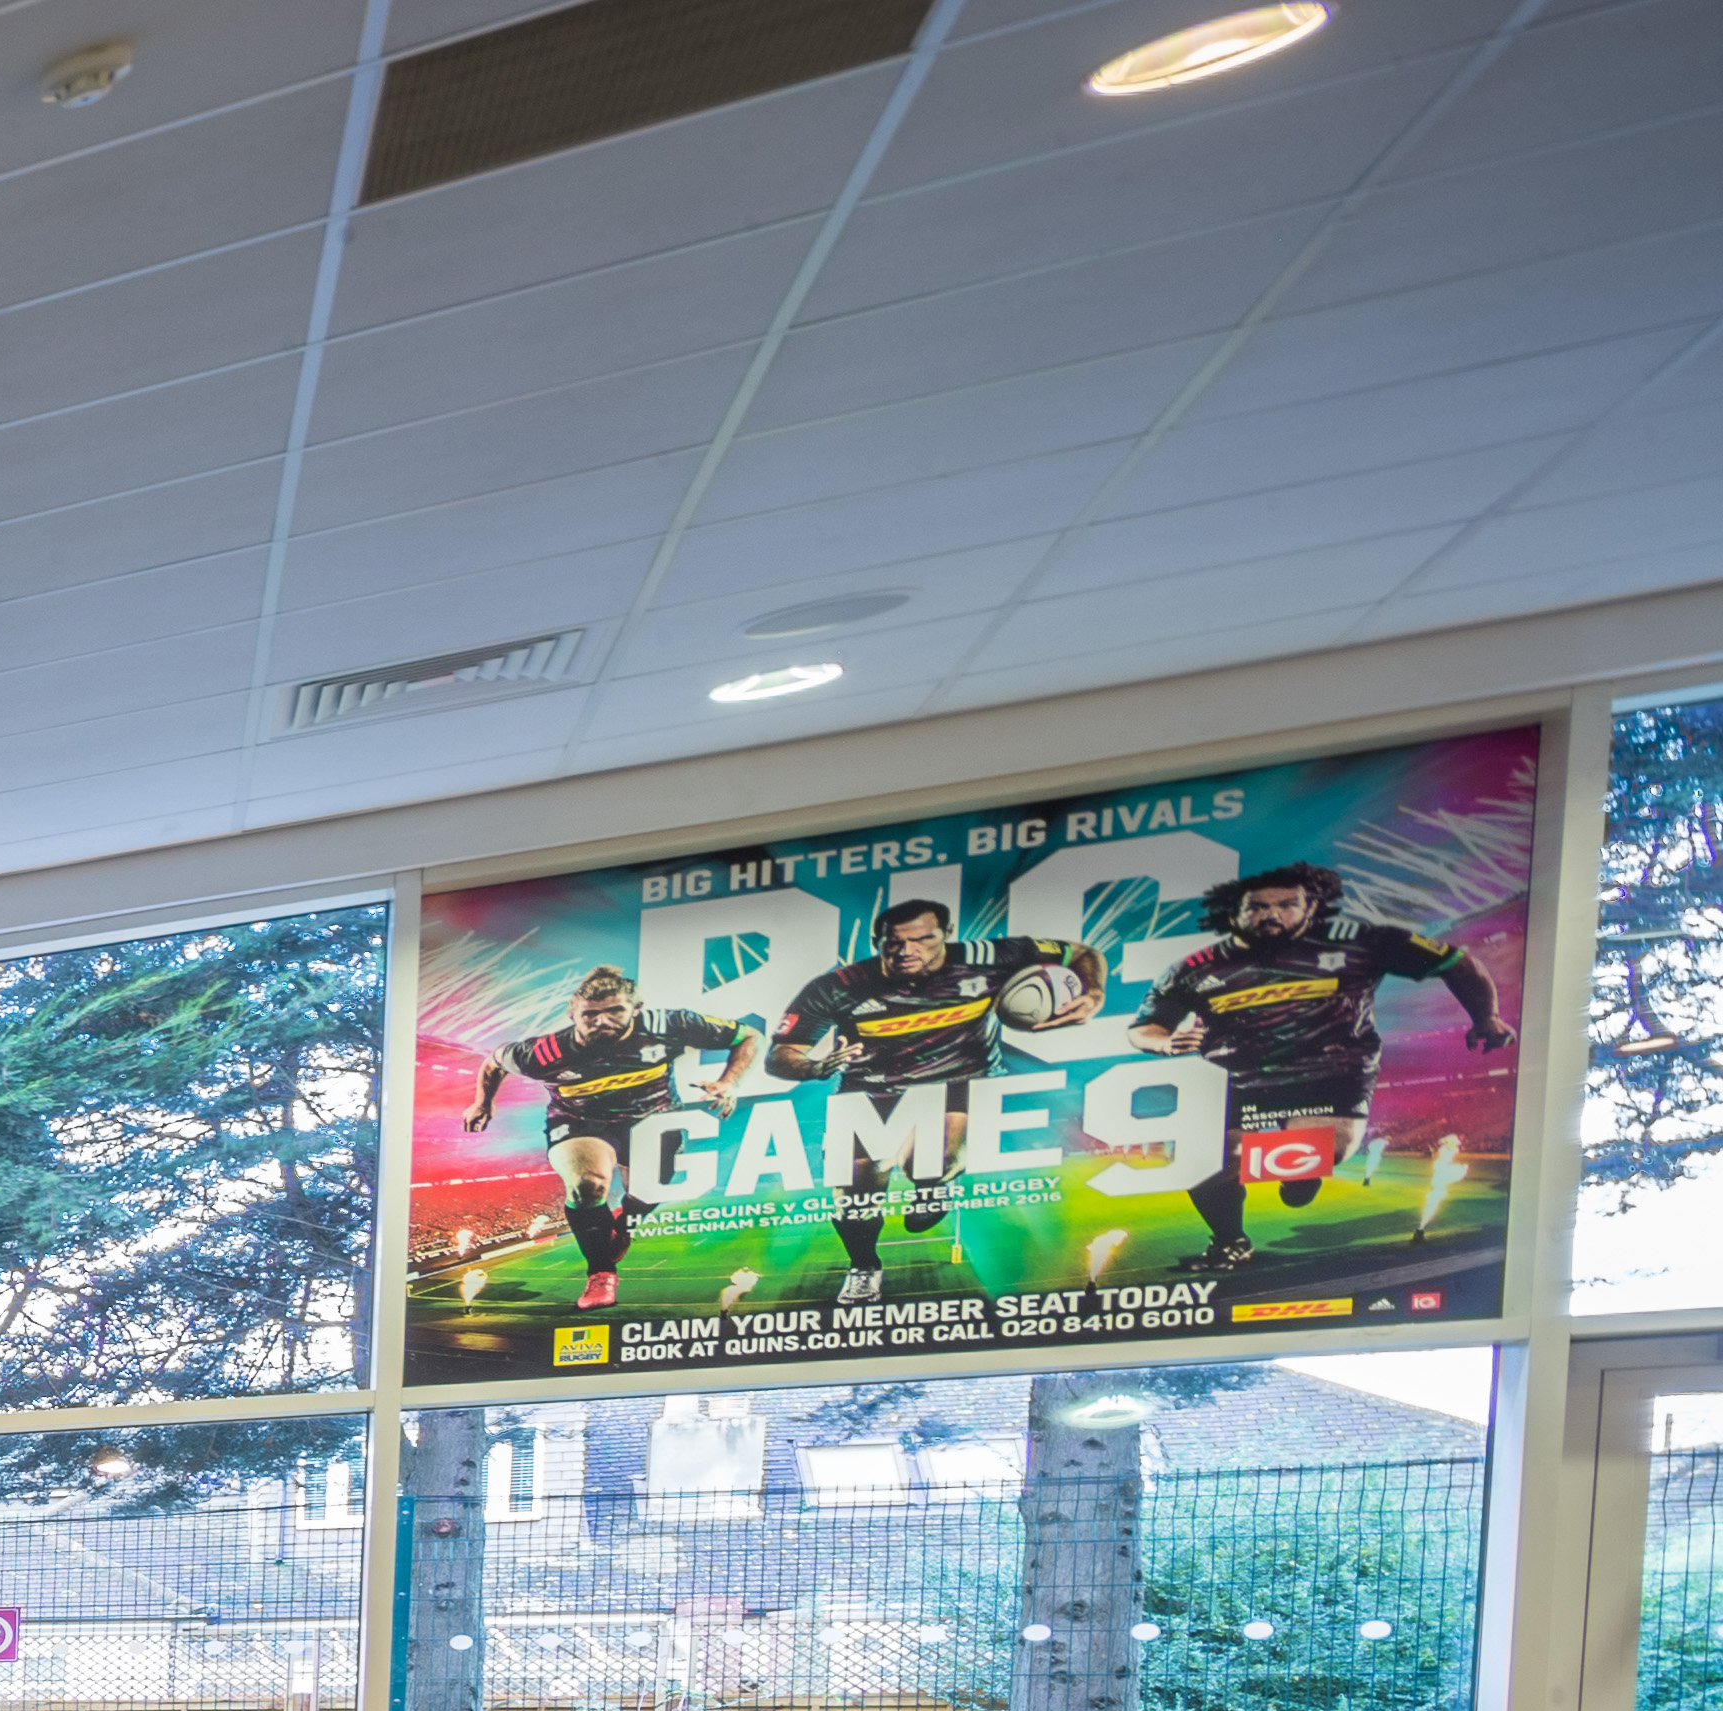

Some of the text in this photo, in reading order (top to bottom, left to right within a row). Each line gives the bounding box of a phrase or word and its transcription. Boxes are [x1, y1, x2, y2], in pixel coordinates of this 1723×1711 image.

[642, 789, 1244, 902] BIG HITTERS, BIG RIVALS
[878, 1009, 973, 1034] DHL
[1241, 1104, 1257, 1114] IN
[1241, 1105, 1335, 1122] ASSOCIATION
[628, 1055, 1229, 1205] GAME 9
[1241, 1120, 1279, 1131] WITH
[1249, 1143, 1322, 1180] IG
[626, 1176, 1062, 1227] HARLEQUINS v GLOUCESTER RUGBY
[626, 1217, 754, 1239] TWICKENHAM
[847, 1206, 895, 1223] 27TH
[900, 1196, 1011, 1216] DECEMBER
[1014, 1190, 1063, 1206] 2016
[621, 1281, 1218, 1345] CLAIM YOUR MEMBER SEAT TODAY
[1249, 1301, 1343, 1317] DHL
[1413, 1294, 1438, 1311] IG
[559, 1341, 604, 1352] AVIVA
[620, 1306, 1216, 1363] BOOK AT QUINS.CO.UK OR CALL 020 8410 6010
[558, 1353, 603, 1364] RUGBY
